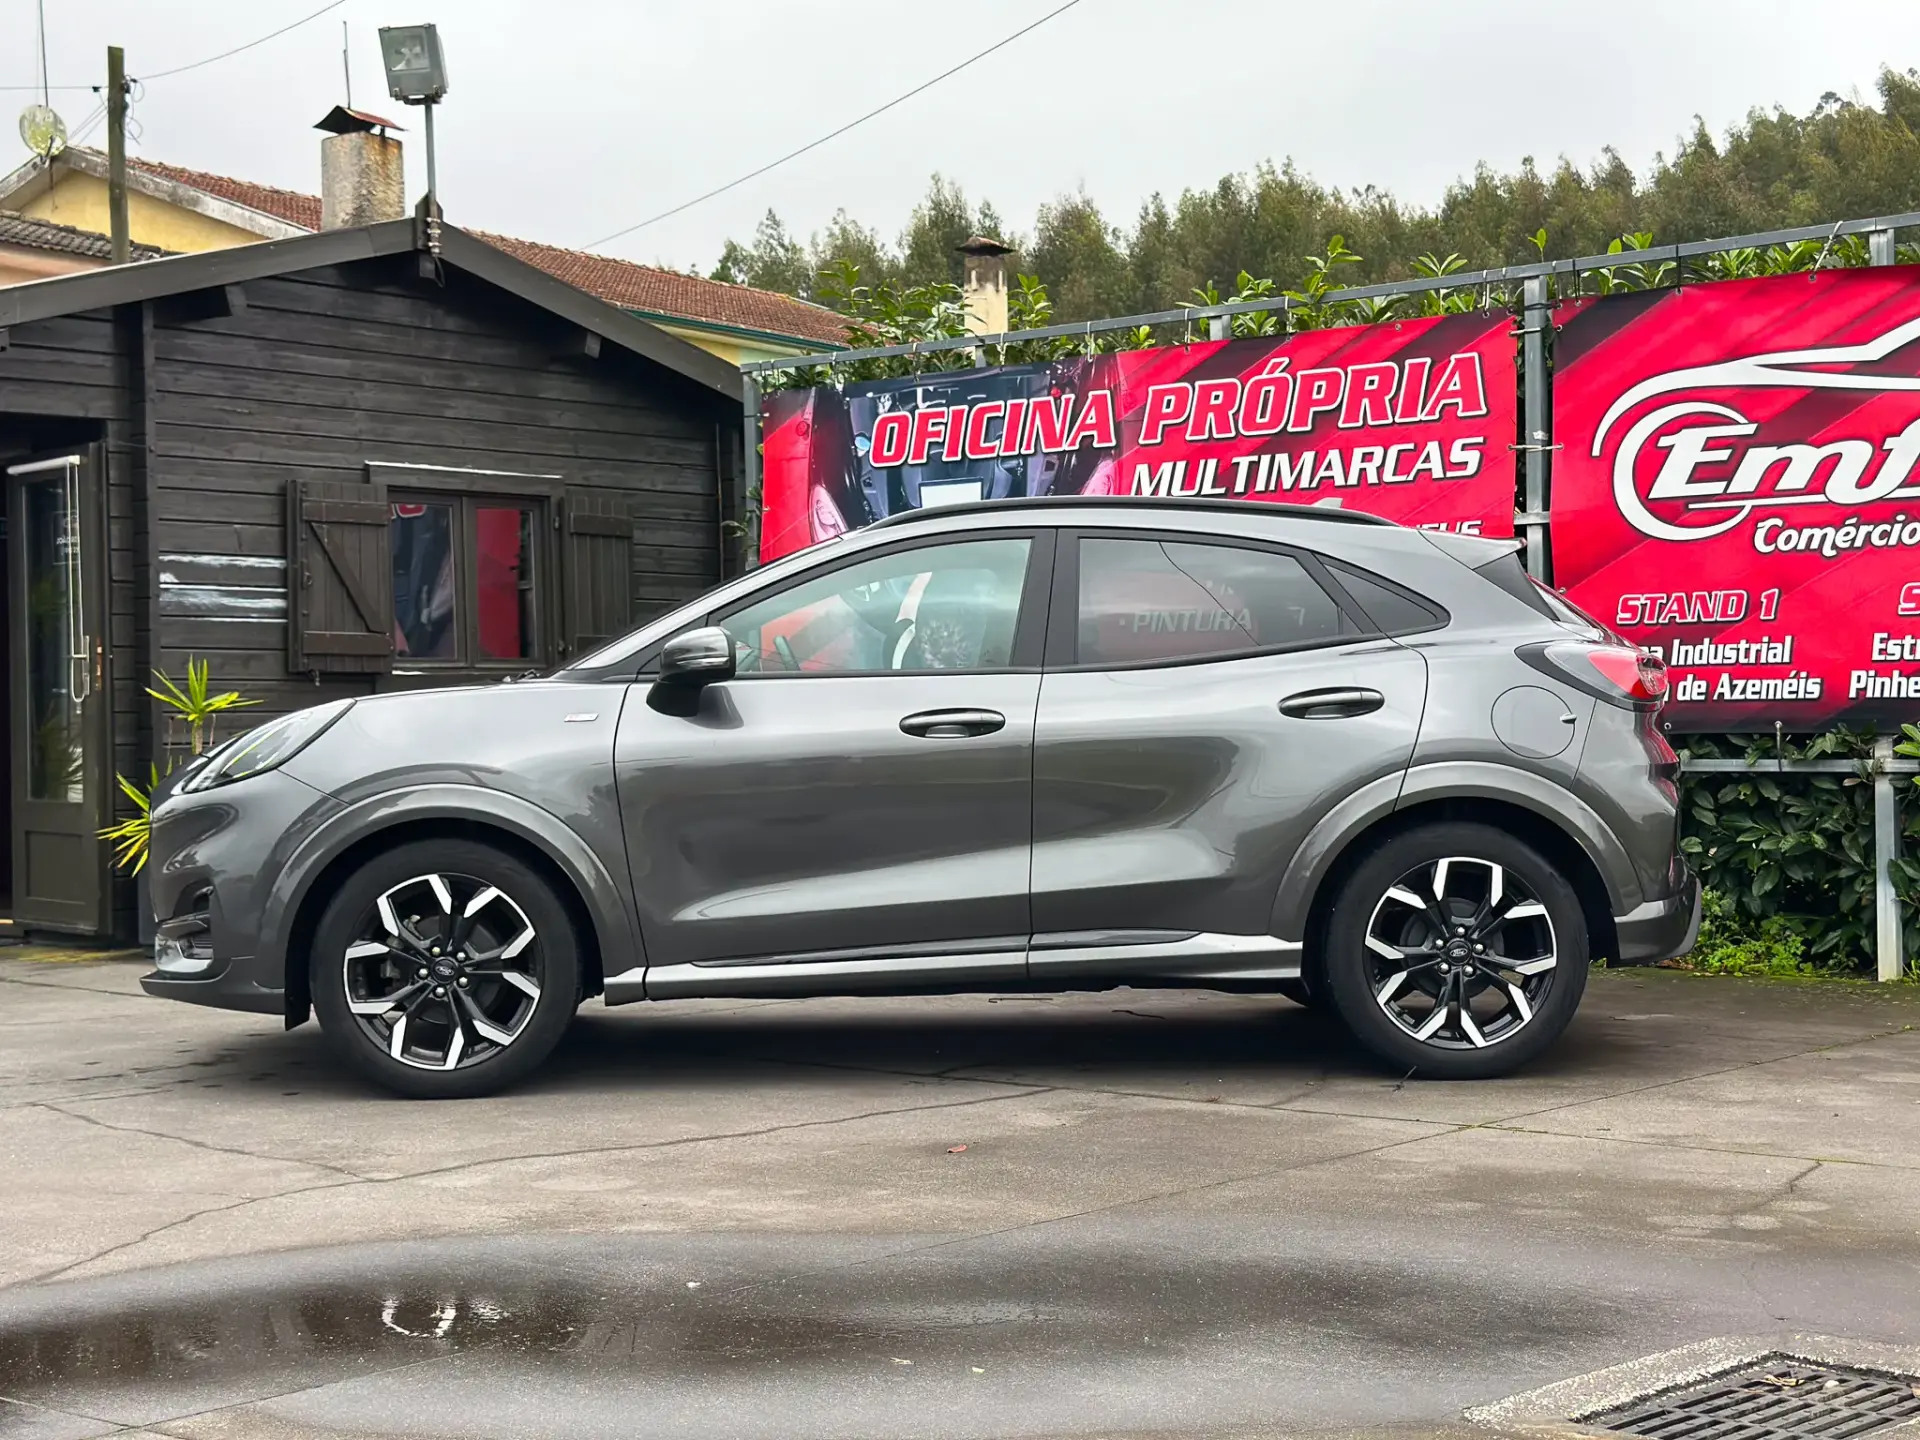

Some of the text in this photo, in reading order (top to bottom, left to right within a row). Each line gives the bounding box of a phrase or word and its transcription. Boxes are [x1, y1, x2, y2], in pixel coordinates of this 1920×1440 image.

[869, 352, 1487, 468] OFICINA PRÓPRIA
[1131, 436, 1485, 497] MULTIMARCAS
[1754, 514, 1920, 557] Comércio
[1132, 608, 1252, 633] PINTURA
[1616, 588, 1780, 624] STAND 1
[1671, 635, 1793, 666] Industrial
[1676, 674, 1707, 701] de
[1713, 669, 1822, 700] Azeméis
